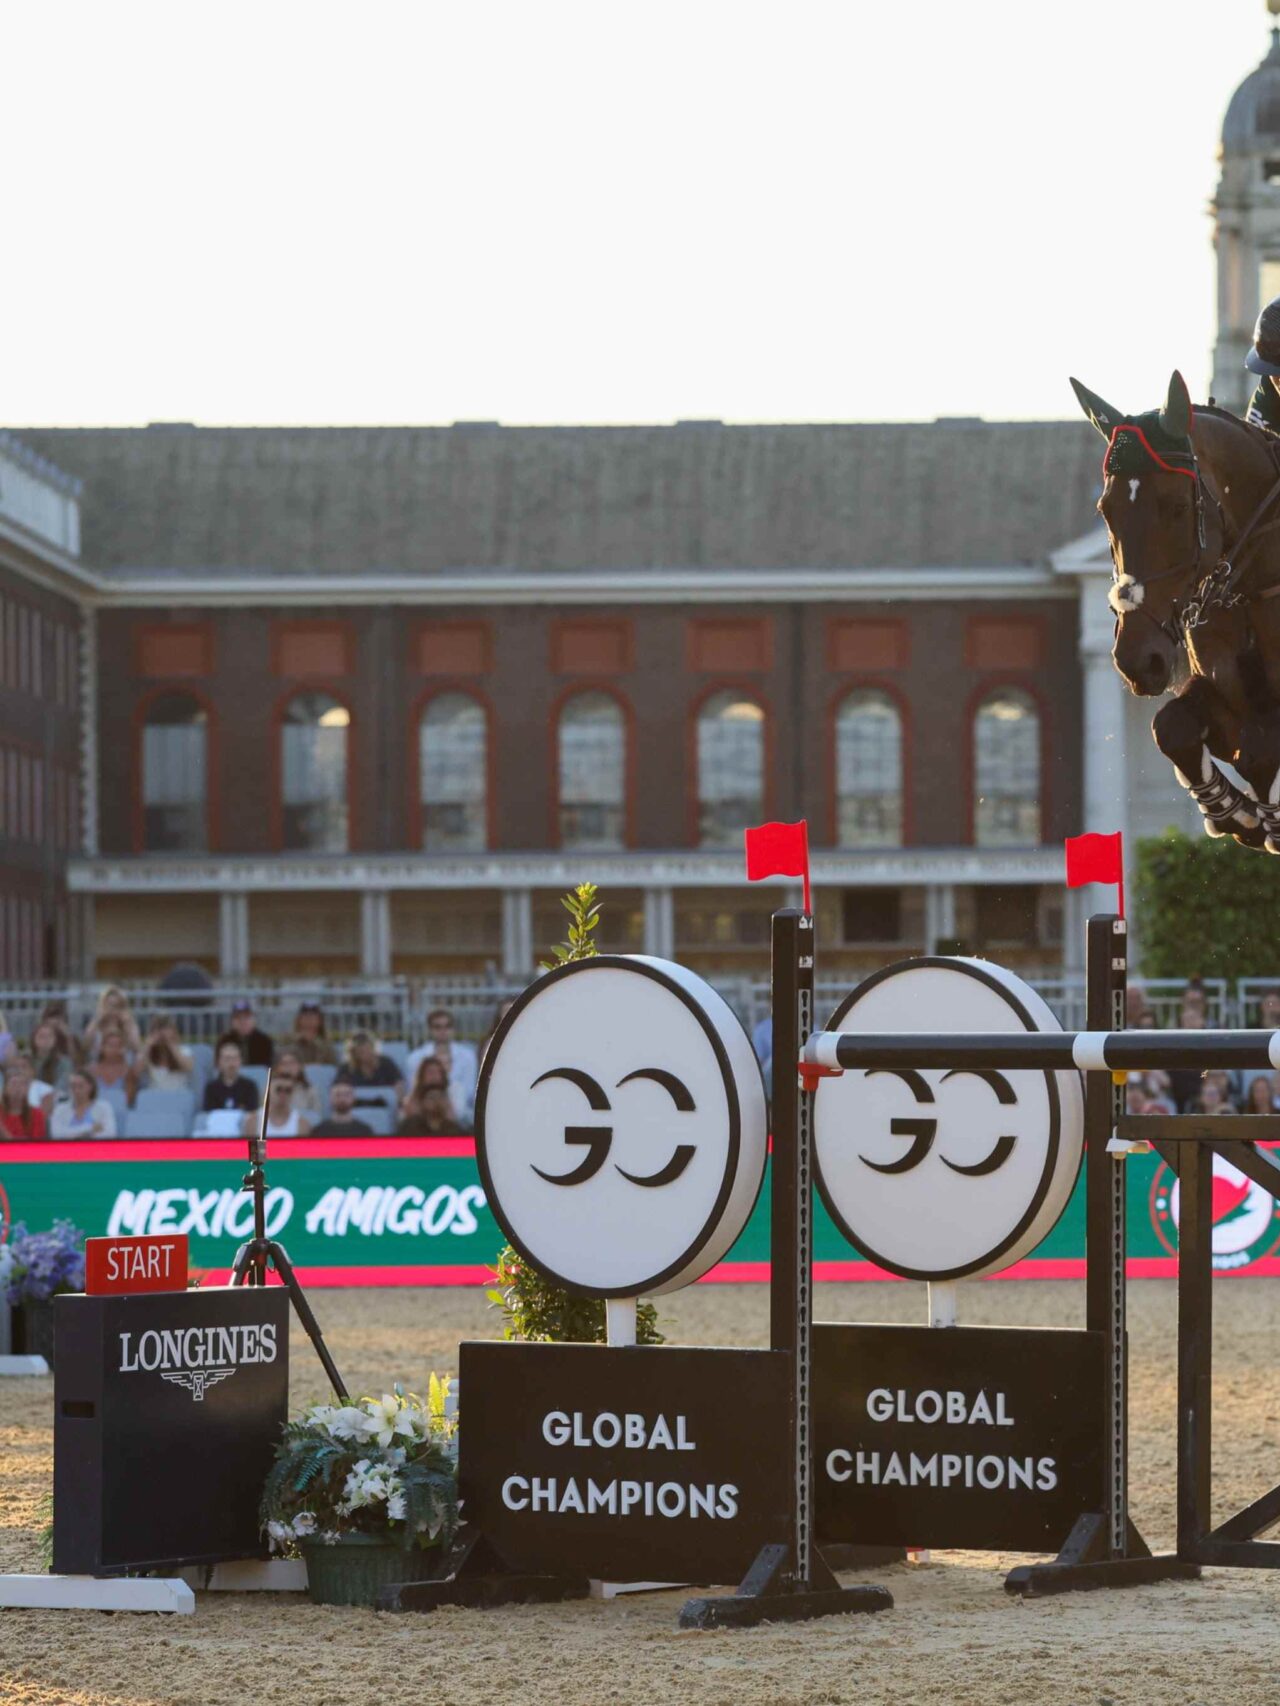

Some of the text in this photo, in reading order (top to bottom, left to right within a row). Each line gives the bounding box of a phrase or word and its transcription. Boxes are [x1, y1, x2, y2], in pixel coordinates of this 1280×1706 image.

[107, 1184, 486, 1237] MEXICO AMIGOS
[106, 1244, 175, 1281] START
[119, 1323, 277, 1372] LONGINES
[867, 1388, 1015, 1426] GLOBAL
[543, 1411, 696, 1451] GLOBAL
[826, 1449, 1058, 1491] CHAMPIONS
[502, 1475, 739, 1519] CHAMPIONS
